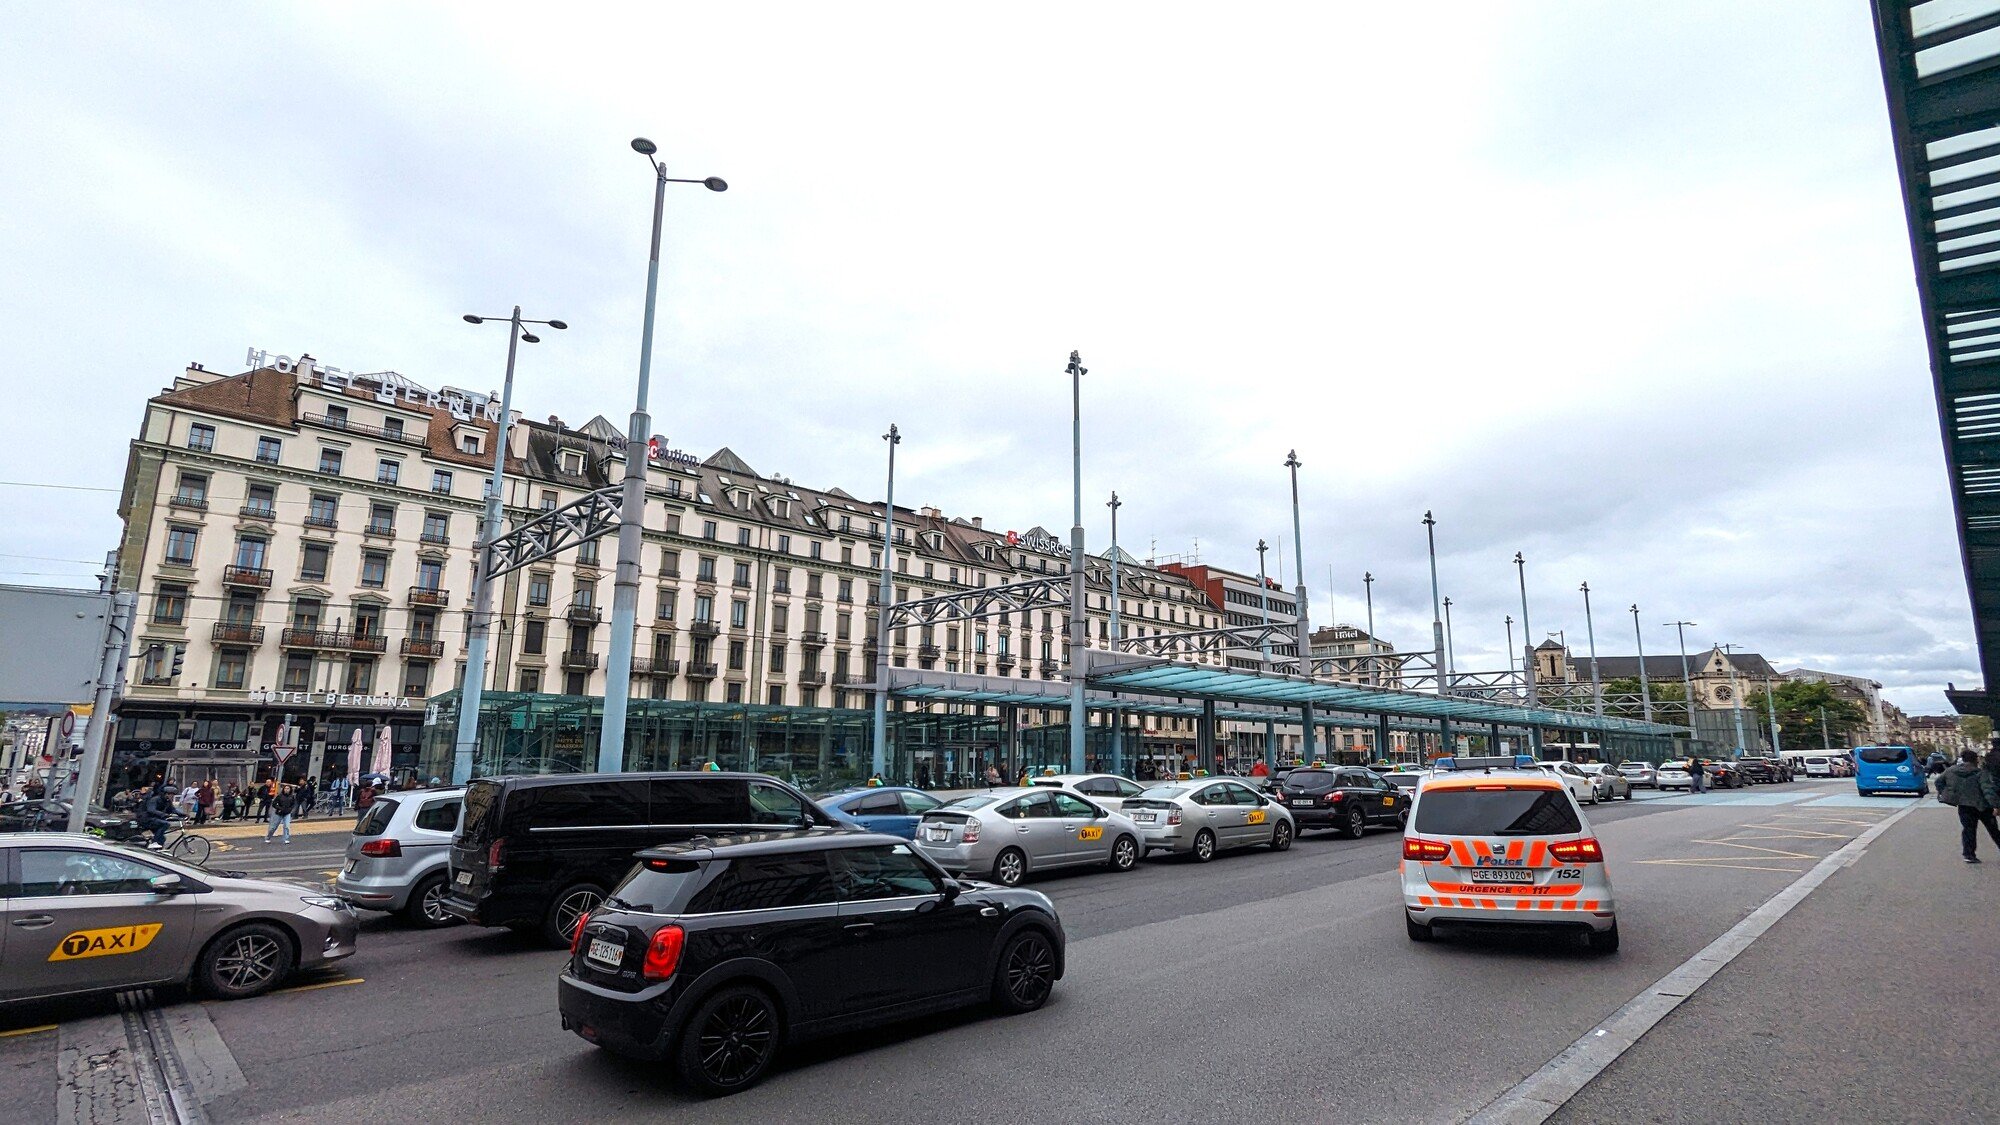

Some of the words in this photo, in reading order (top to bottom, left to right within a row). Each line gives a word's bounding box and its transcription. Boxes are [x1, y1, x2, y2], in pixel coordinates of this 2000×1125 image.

[246, 347, 356, 390] HOTEL
[381, 380, 519, 429] BERNINA
[1335, 630, 1358, 639] Hôtel
[249, 690, 315, 704] HOTEL
[326, 694, 410, 708] BERNINA
[1477, 856, 1523, 866] POLICE
[1556, 869, 1581, 879] 152
[1460, 886, 1512, 894] URGENCE
[1532, 886, 1551, 895] 117
[62, 926, 137, 957] TAXI
